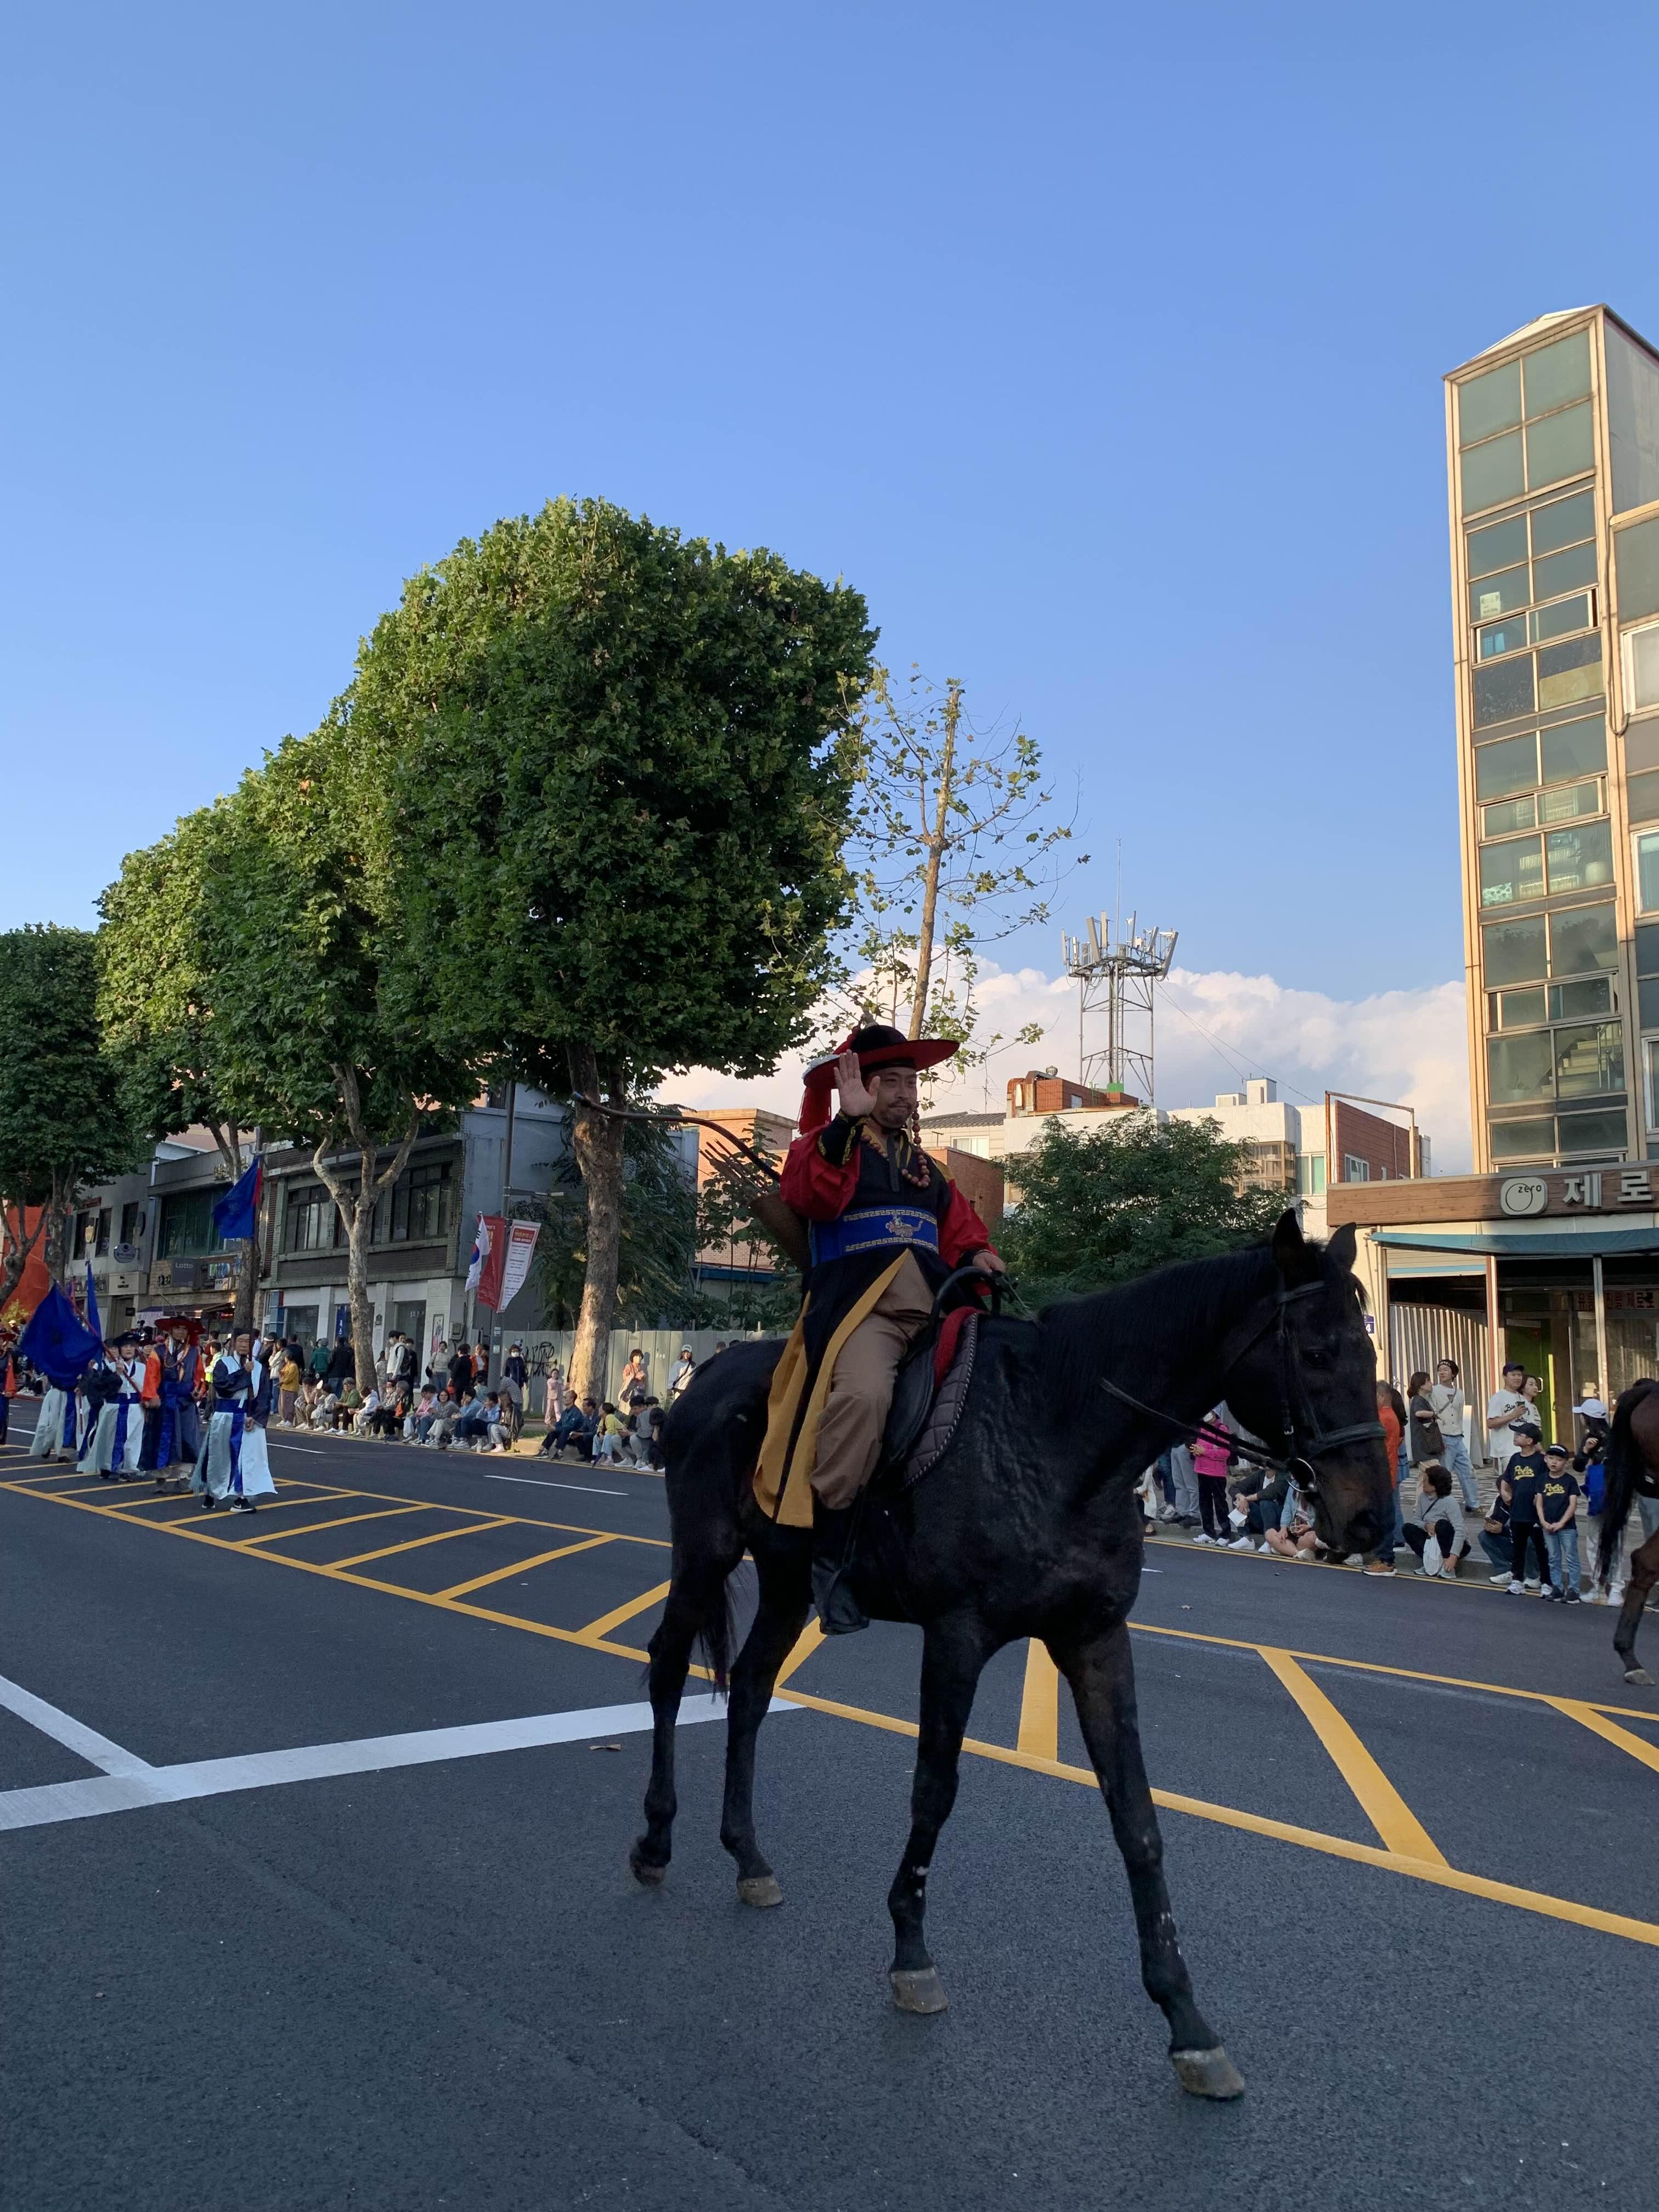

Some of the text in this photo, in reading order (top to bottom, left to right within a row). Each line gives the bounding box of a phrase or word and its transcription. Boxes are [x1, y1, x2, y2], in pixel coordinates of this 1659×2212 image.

[1562, 1171, 1653, 1208] 제로
[1514, 1465, 1534, 1478] Polo
[1544, 1483, 1565, 1494] Polo
